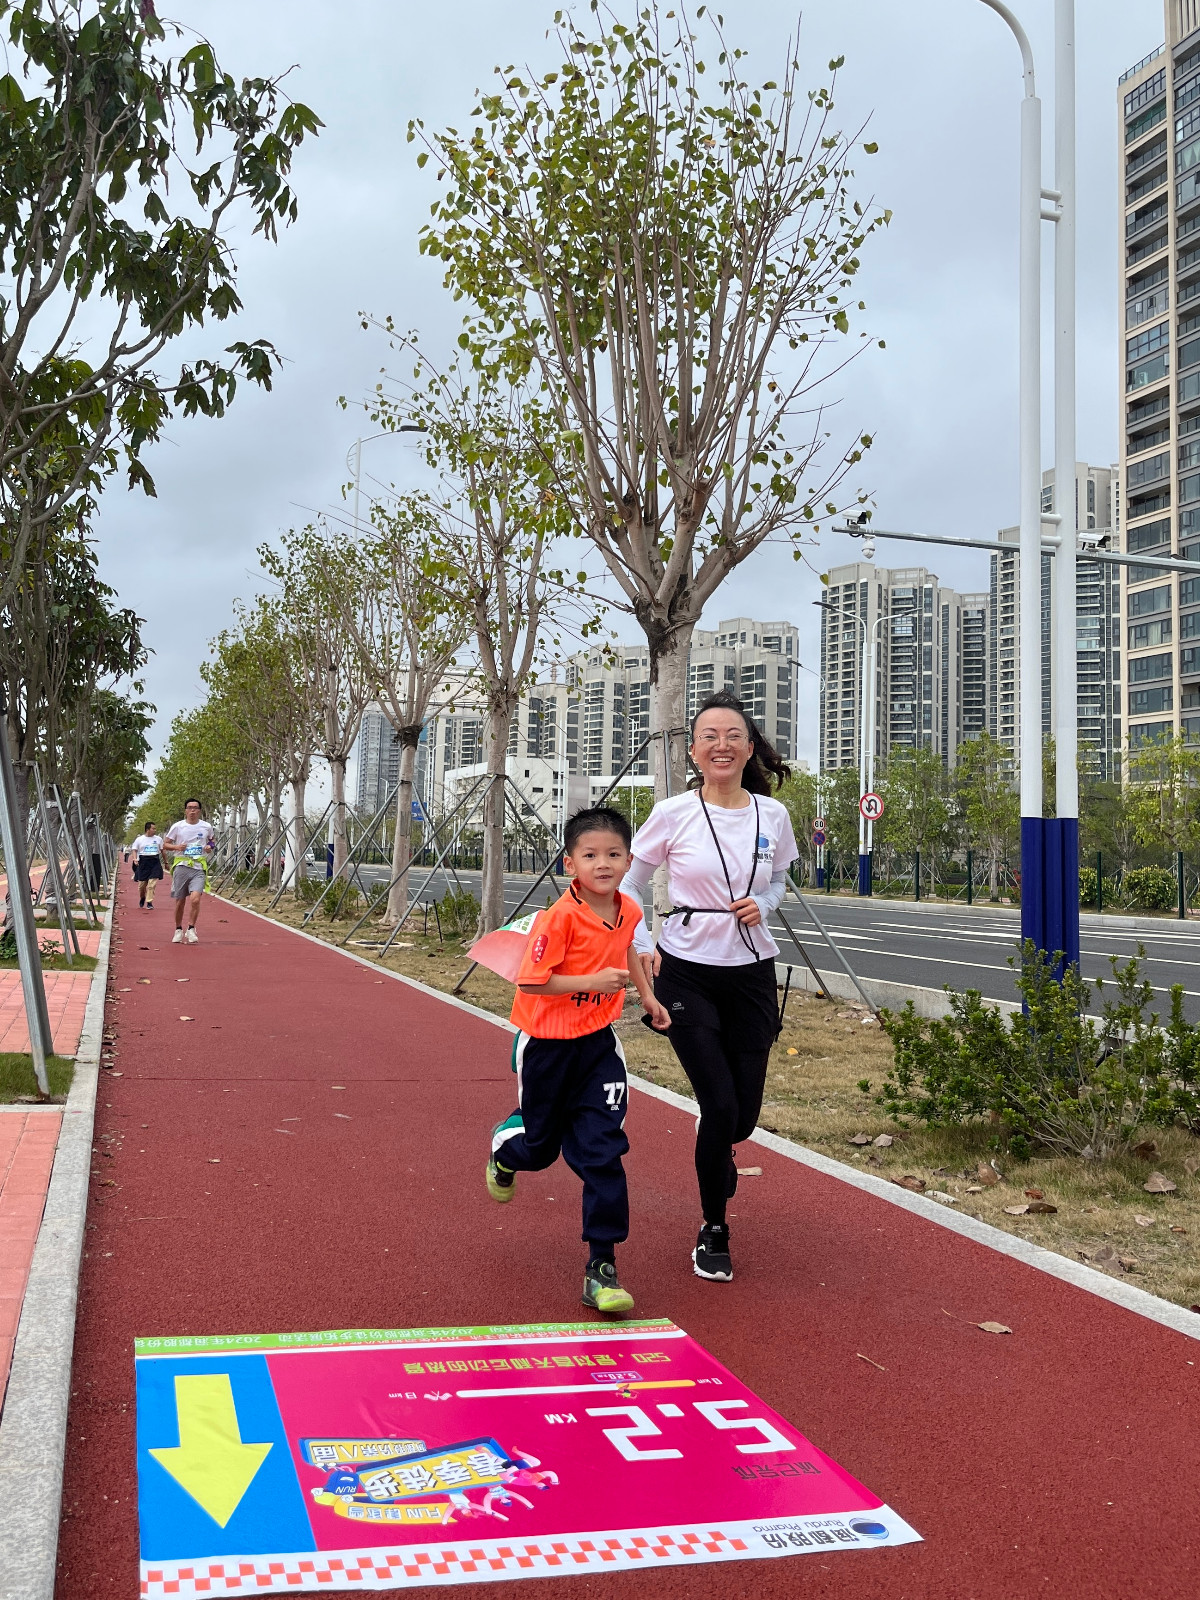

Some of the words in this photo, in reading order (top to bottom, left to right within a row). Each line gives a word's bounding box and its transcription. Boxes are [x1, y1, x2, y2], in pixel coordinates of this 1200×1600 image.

[603, 1081, 625, 1105] 77
[711, 1377, 723, 1385] 0
[544, 1412, 578, 1425] KM
[583, 1398, 797, 1462] 5.2
[364, 1452, 507, 1501] 春季徒步
[731, 1461, 822, 1480] 你已完成
[334, 1485, 357, 1494] RUN
[405, 1506, 441, 1519] FUN
[752, 1522, 800, 1533] Pharma
[803, 1519, 845, 1530] Rundu
[760, 1527, 860, 1549] 润都股份
